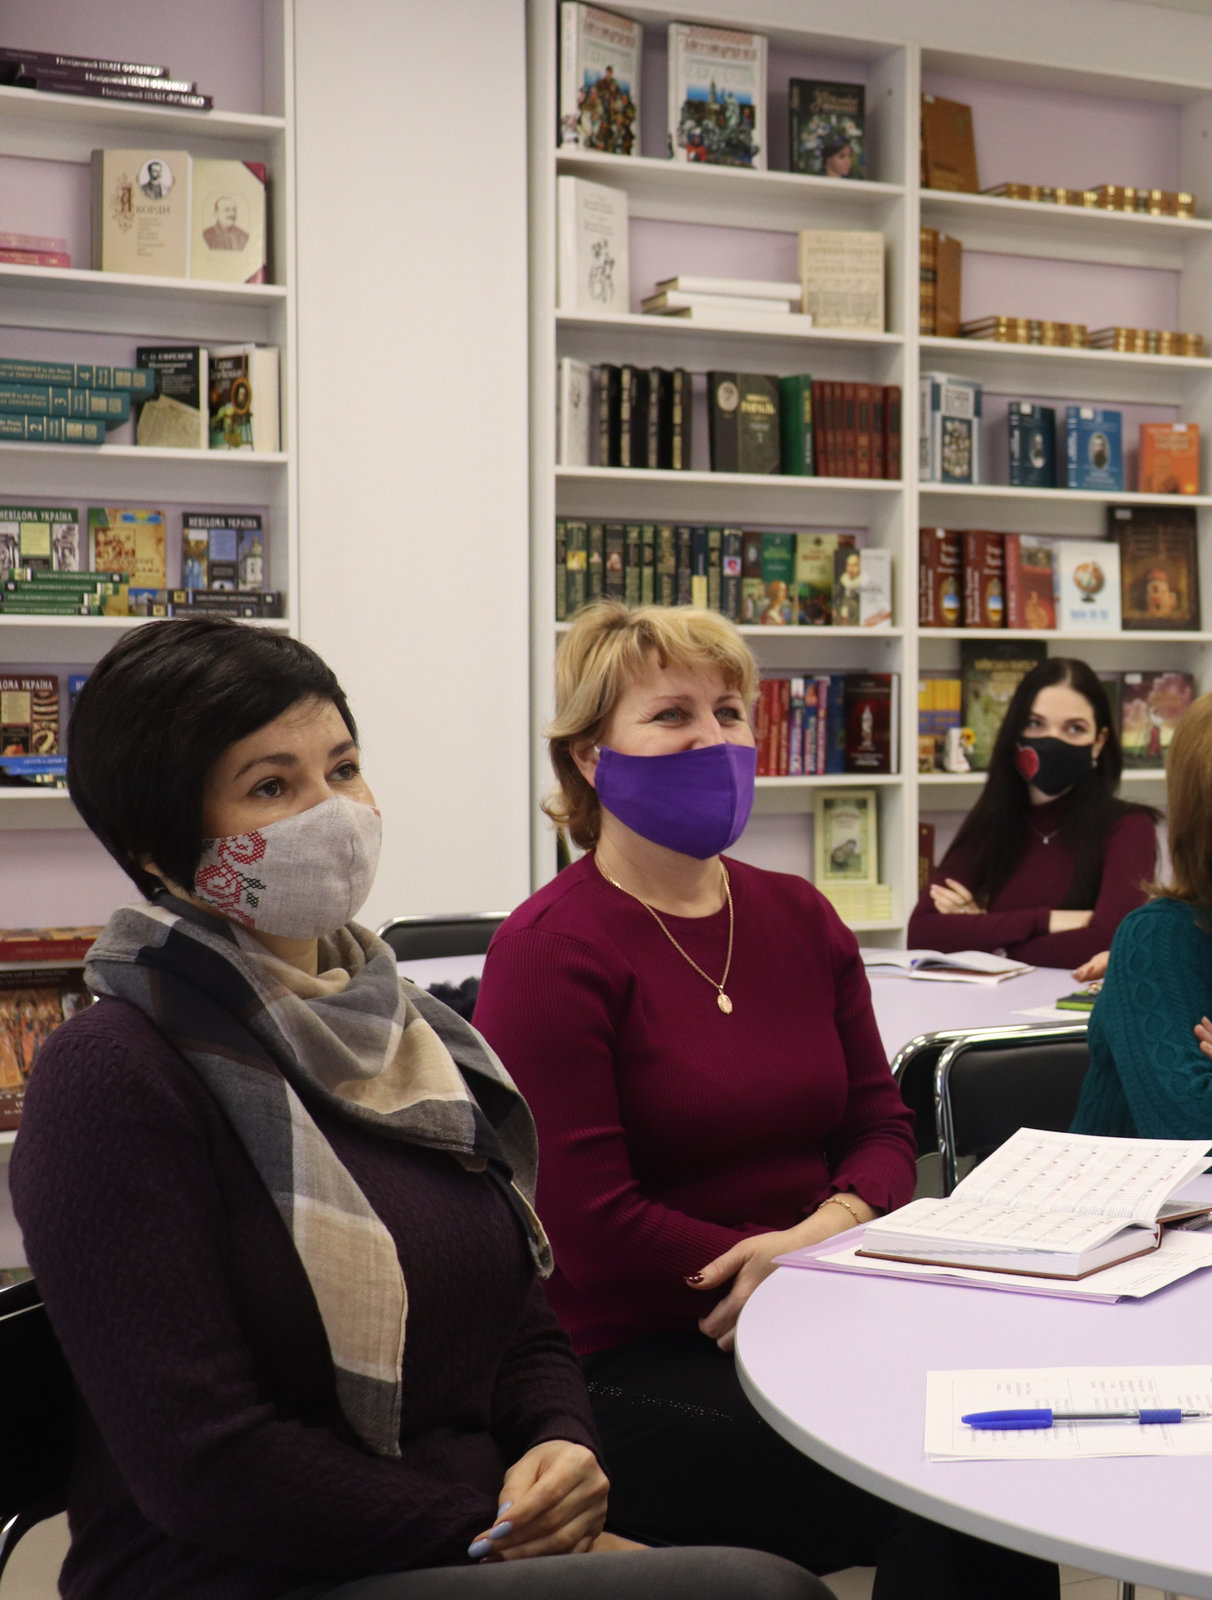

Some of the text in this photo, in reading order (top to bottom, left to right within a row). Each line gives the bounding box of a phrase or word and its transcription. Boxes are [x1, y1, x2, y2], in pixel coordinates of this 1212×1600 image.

[121, 63, 162, 77] ФРАНКО
[150, 78, 190, 93] ФРАНКО
[40, 510, 73, 523] УКРАЇНА
[188, 516, 258, 530] НЕВІДОМА УКРАЇНА
[21, 679, 54, 691] УКРАЇНА
